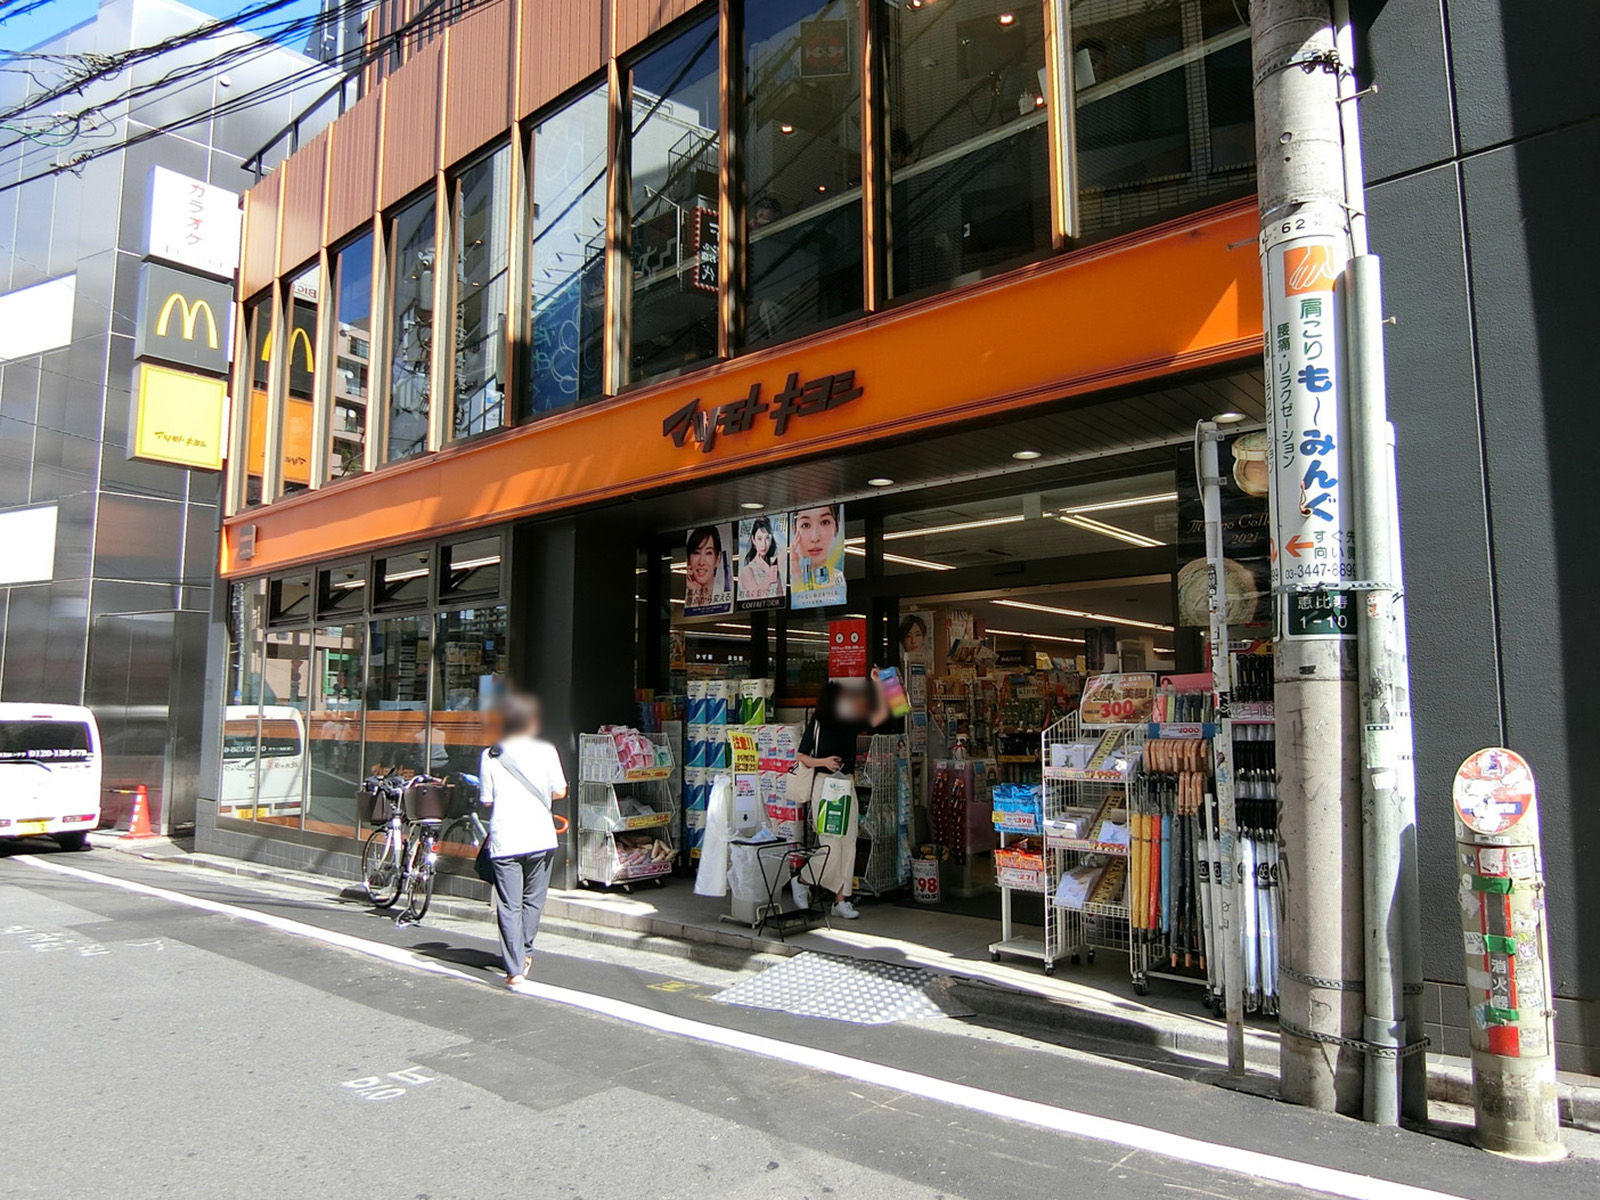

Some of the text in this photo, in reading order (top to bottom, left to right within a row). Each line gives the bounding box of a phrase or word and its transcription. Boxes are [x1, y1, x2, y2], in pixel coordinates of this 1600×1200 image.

[186, 184, 205, 246] カラオケ
[662, 369, 865, 454] マツモトキヨシ
[1297, 594, 1348, 610] 恵比寿
[1299, 614, 1348, 630] 1-10
[1100, 699, 1135, 719] 300
[917, 878, 938, 893] 98
[1491, 958, 1510, 1009] 消火器
